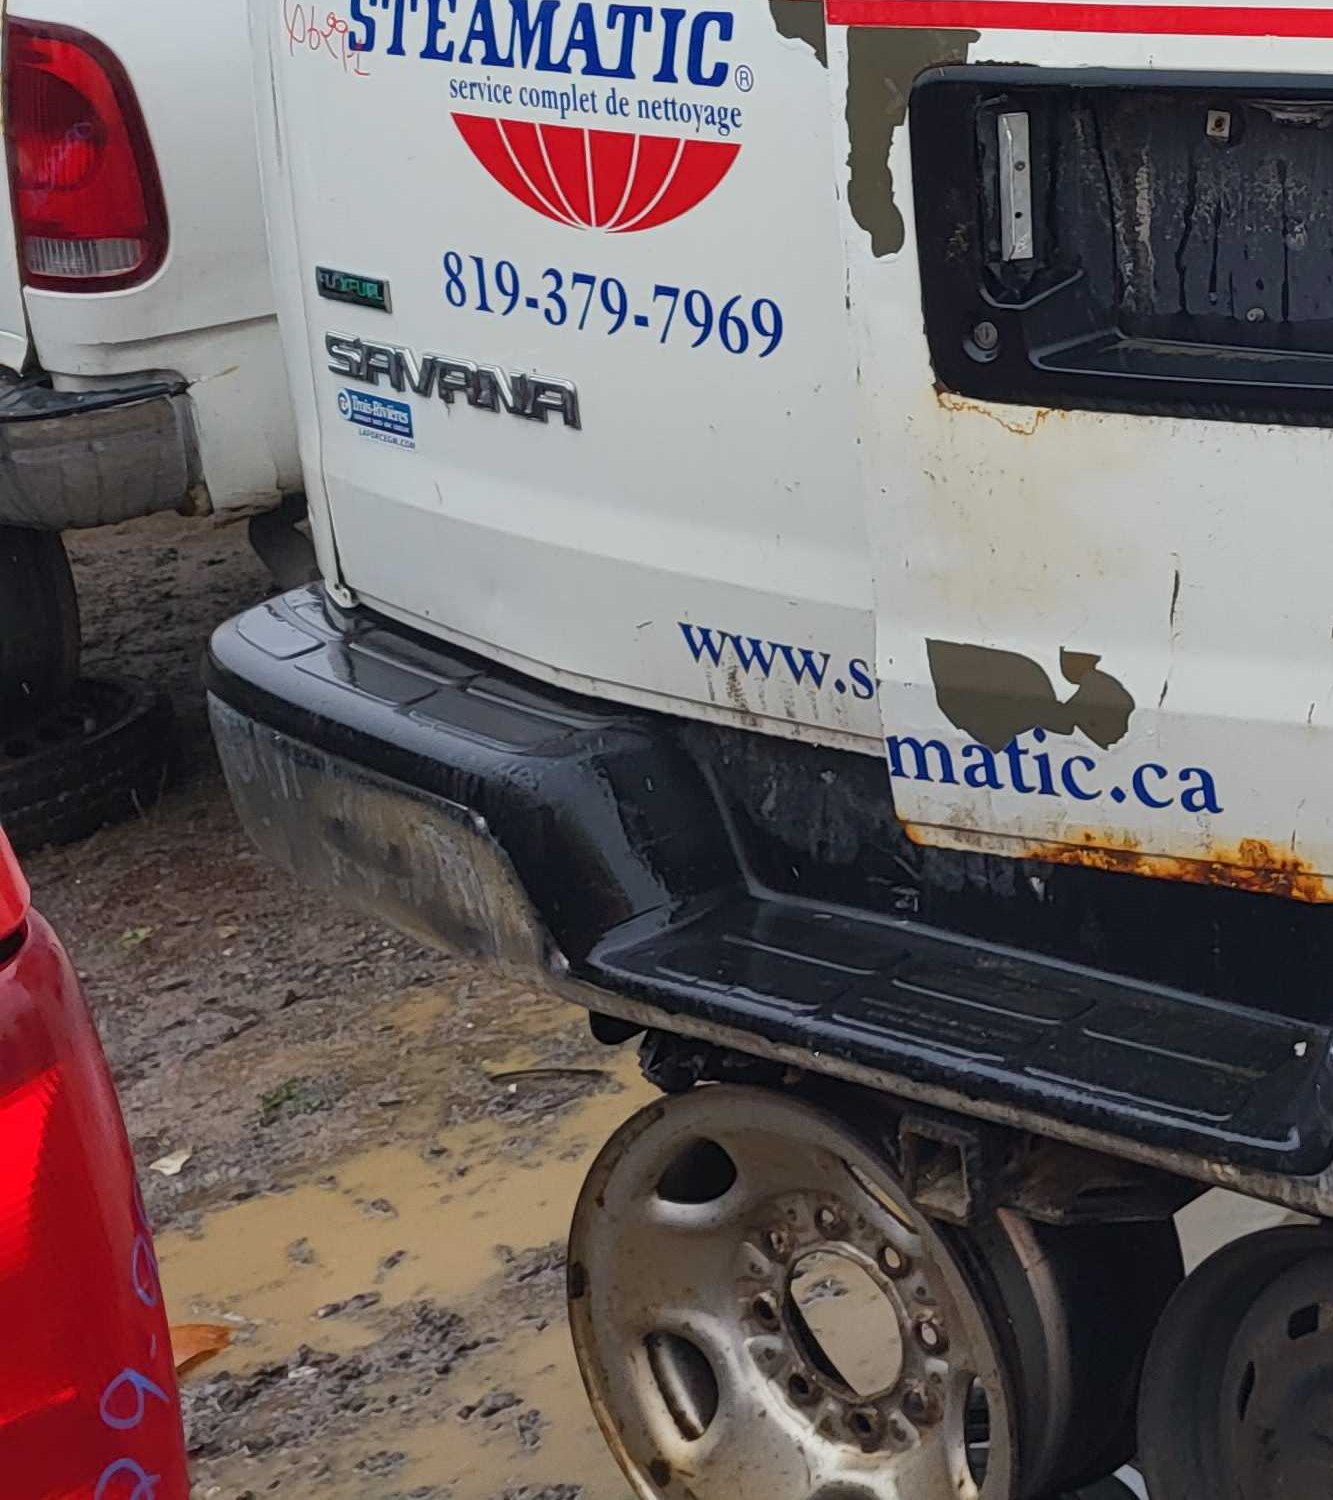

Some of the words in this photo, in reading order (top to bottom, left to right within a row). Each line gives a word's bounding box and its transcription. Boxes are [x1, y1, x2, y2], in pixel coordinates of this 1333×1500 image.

[450, 75, 512, 105] service
[519, 83, 598, 119] complet
[606, 87, 629, 117] de
[638, 98, 742, 137] nettoyage
[443, 251, 783, 358] 819-379-7969
[325, 330, 582, 430] SAVANA
[678, 622, 876, 700] www.s
[887, 726, 1223, 813] matic.ca
